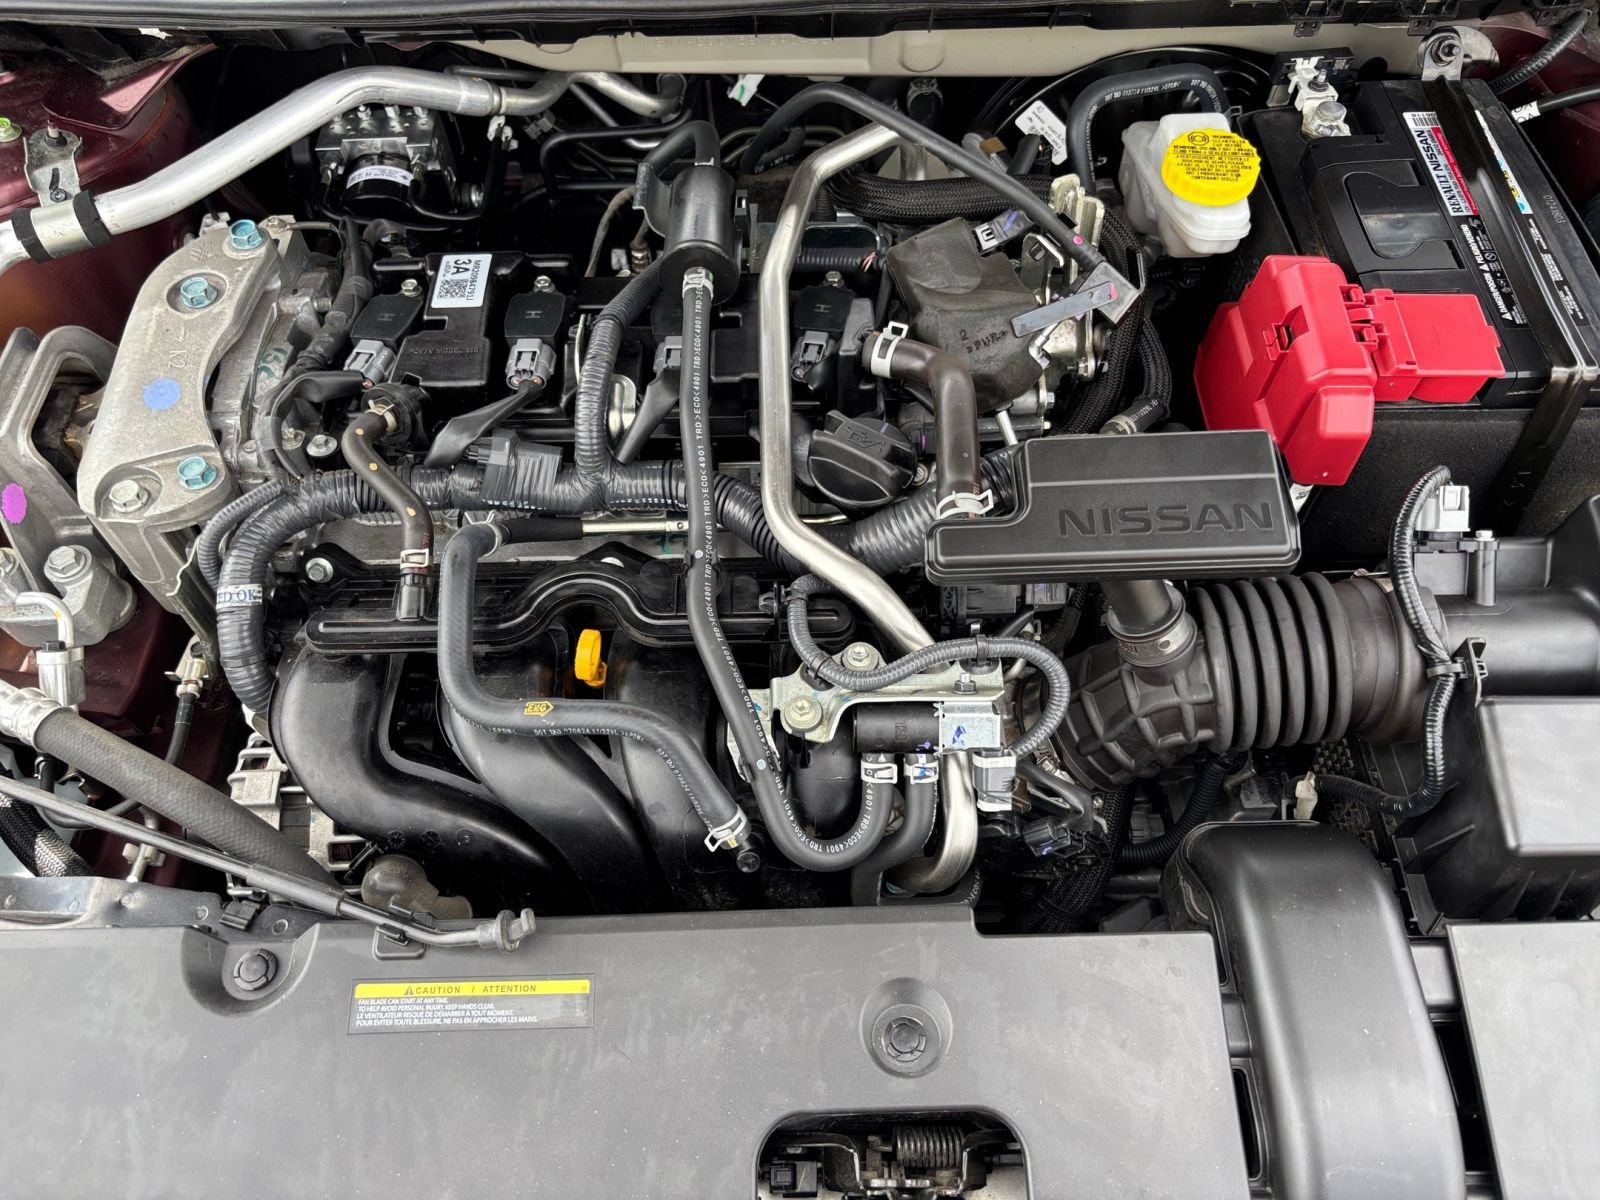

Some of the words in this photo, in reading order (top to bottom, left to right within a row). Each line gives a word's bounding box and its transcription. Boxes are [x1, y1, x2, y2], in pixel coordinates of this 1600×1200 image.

[1415, 129, 1443, 171] NISSAN
[1435, 173, 1464, 213] RENAULT
[451, 259, 472, 276] 3A
[1058, 502, 1274, 537] NISSAN
[415, 986, 461, 994] CAUTION
[482, 984, 537, 993] ATTENTION
